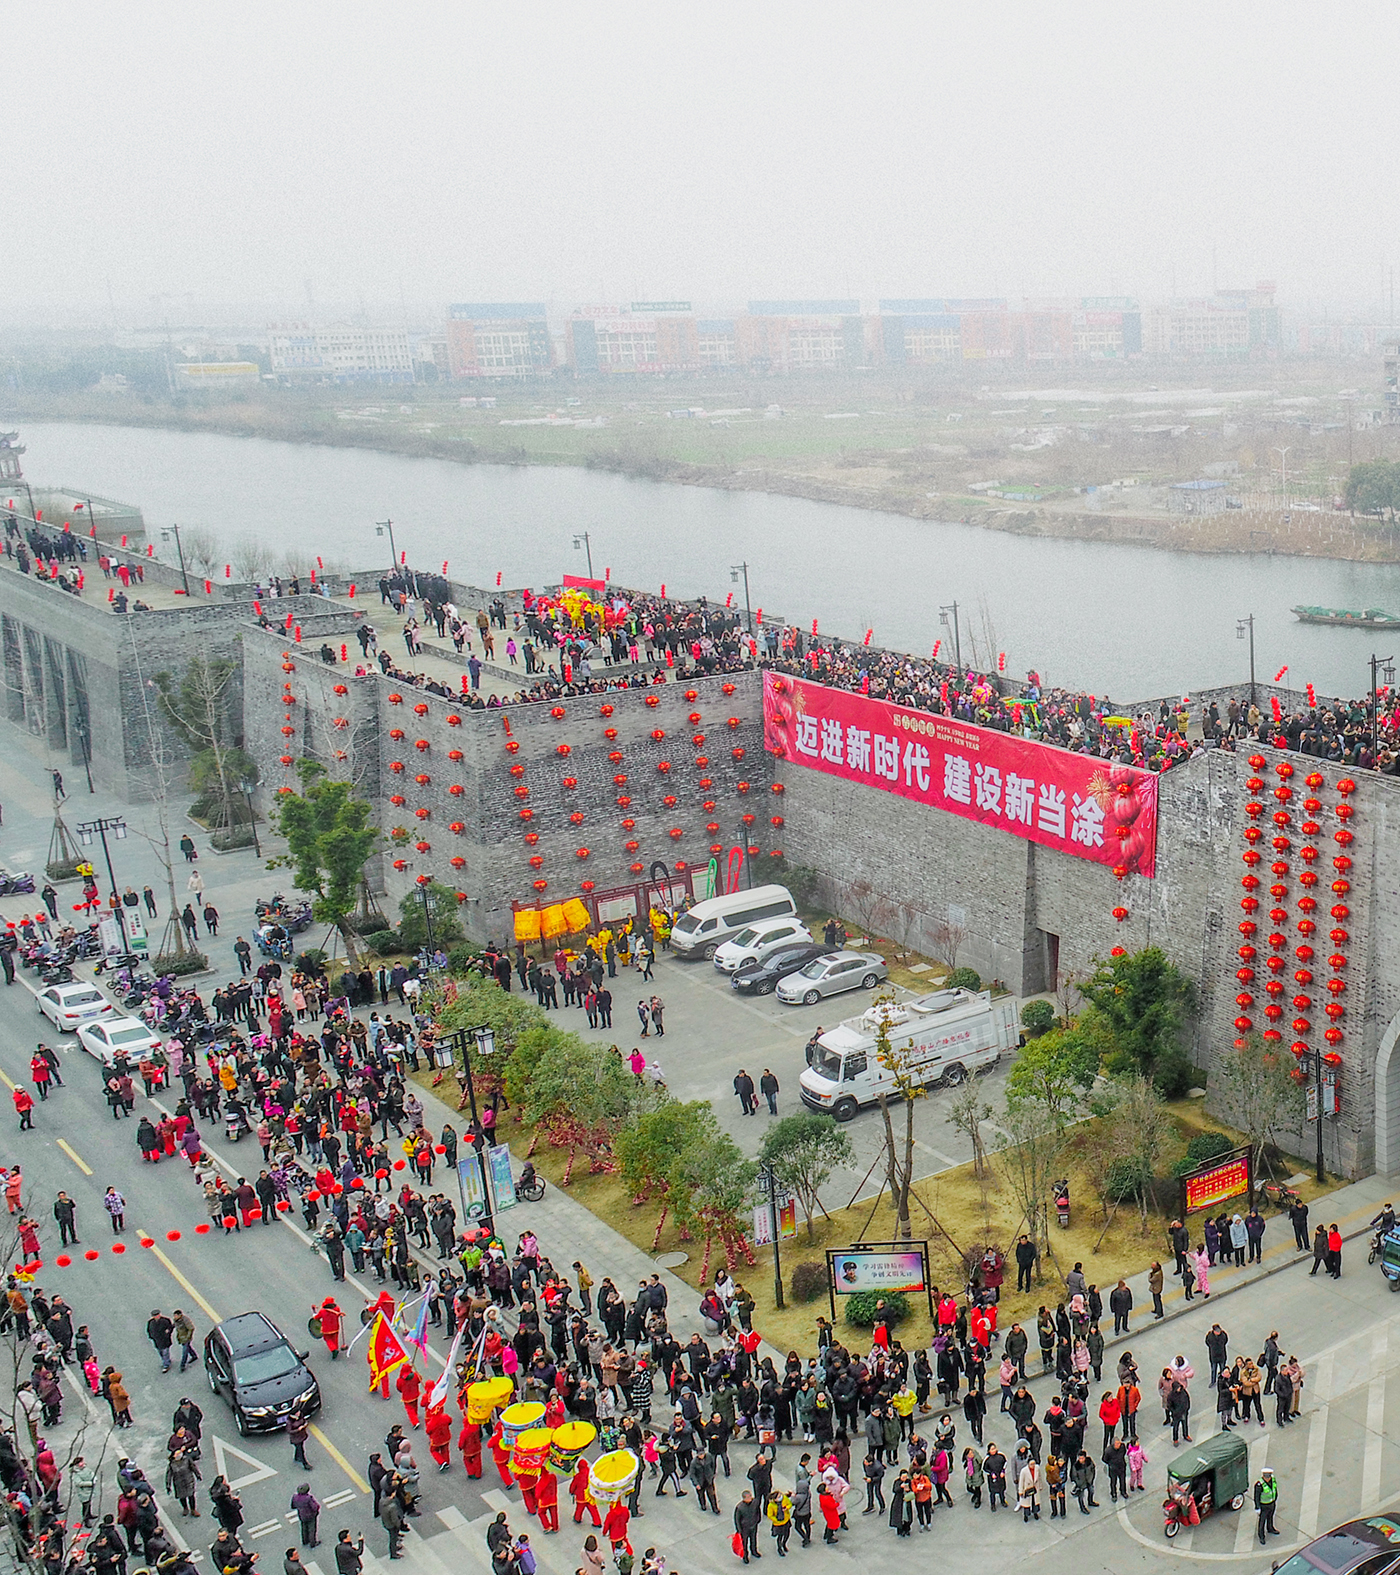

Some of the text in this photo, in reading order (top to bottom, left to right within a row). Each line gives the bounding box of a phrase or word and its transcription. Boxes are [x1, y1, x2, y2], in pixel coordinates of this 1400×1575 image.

[795, 711, 1106, 848] 迈进新时代 建设新当涂
[936, 732, 953, 743] HAPPY
[953, 736, 965, 747] NEW
[965, 741, 980, 751] YEAR
